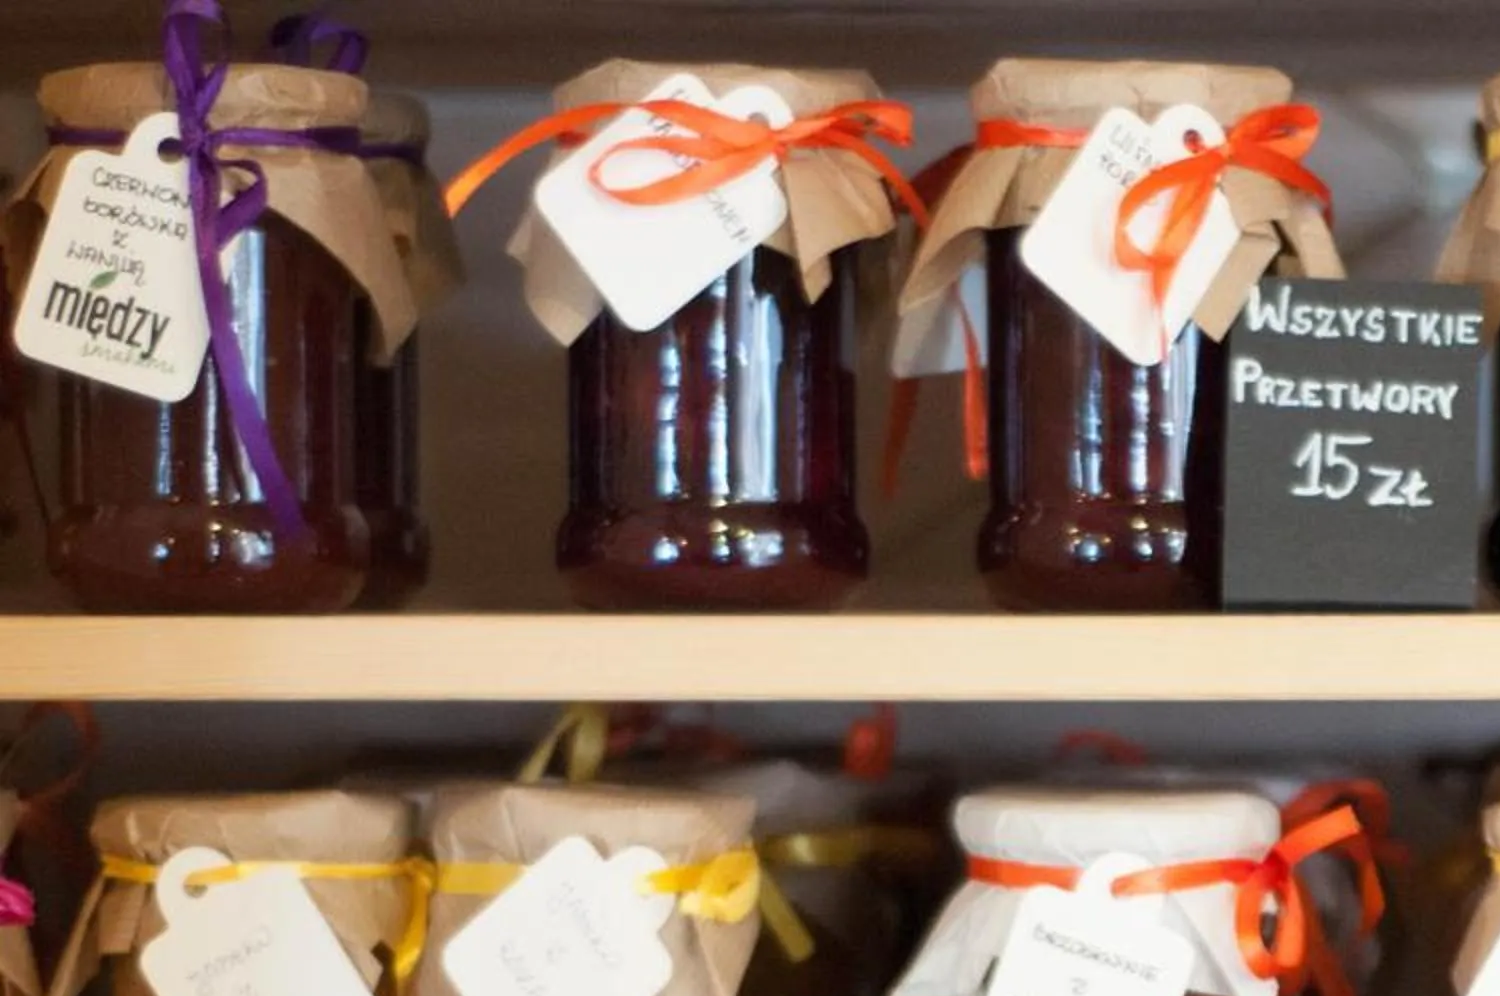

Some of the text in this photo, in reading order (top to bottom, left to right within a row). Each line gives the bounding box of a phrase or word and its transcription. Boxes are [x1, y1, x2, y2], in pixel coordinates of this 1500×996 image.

[92, 166, 193, 210] CZERWON
[43, 280, 170, 360] między
[1246, 285, 1484, 346] WSZYSTKIE
[1232, 357, 1458, 420] PRZETWORY
[1291, 432, 1372, 499] 15
